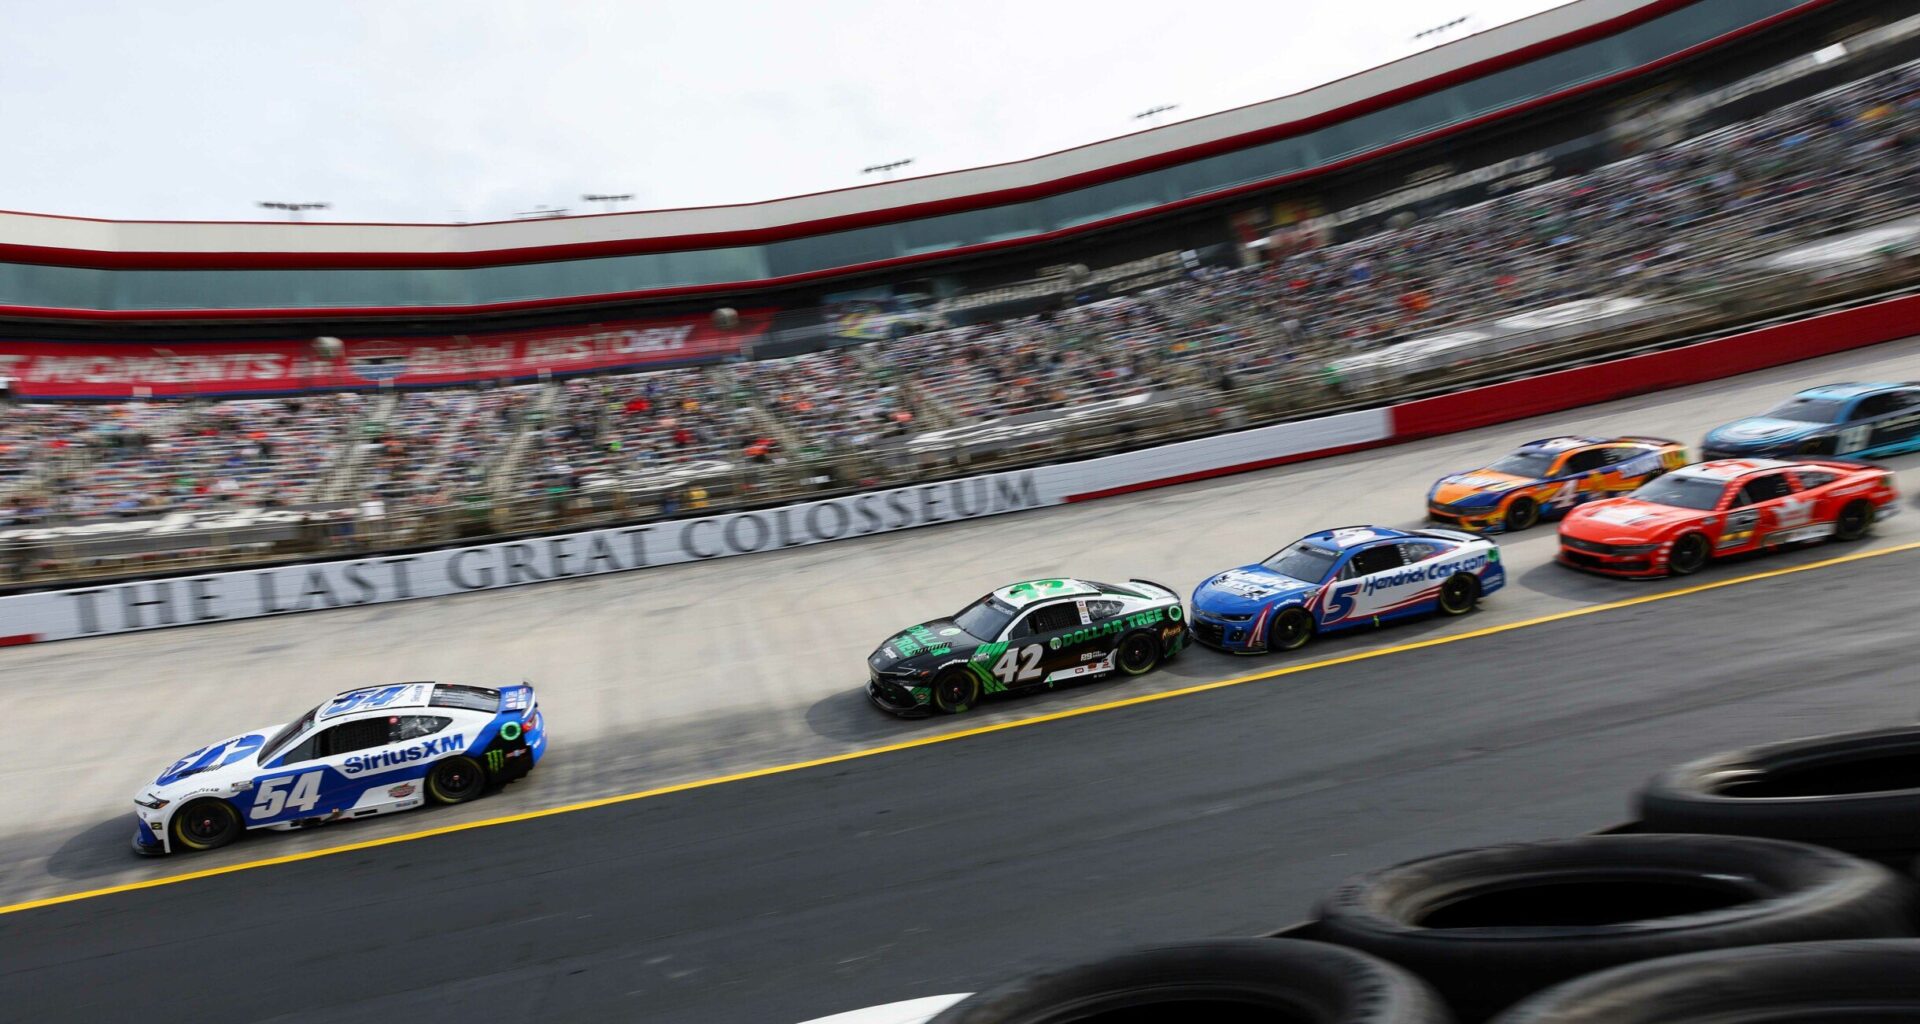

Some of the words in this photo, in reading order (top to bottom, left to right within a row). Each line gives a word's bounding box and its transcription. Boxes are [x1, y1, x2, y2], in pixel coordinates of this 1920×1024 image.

[29, 353, 286, 383] MOMENTS
[524, 324, 695, 364] HISTORY
[1551, 478, 1579, 509] 4
[68, 577, 227, 634] THE
[256, 556, 421, 614] LAST
[446, 527, 656, 592] GREAT
[680, 471, 1041, 557] COLOSSEUM
[1321, 583, 1362, 625] 5
[1062, 620, 1125, 648] DOLLAR
[1126, 608, 1165, 629] TREE
[992, 643, 1044, 684] 42
[321, 684, 410, 717] 54
[343, 733, 465, 775] SiriusXM
[249, 769, 325, 820] 54
